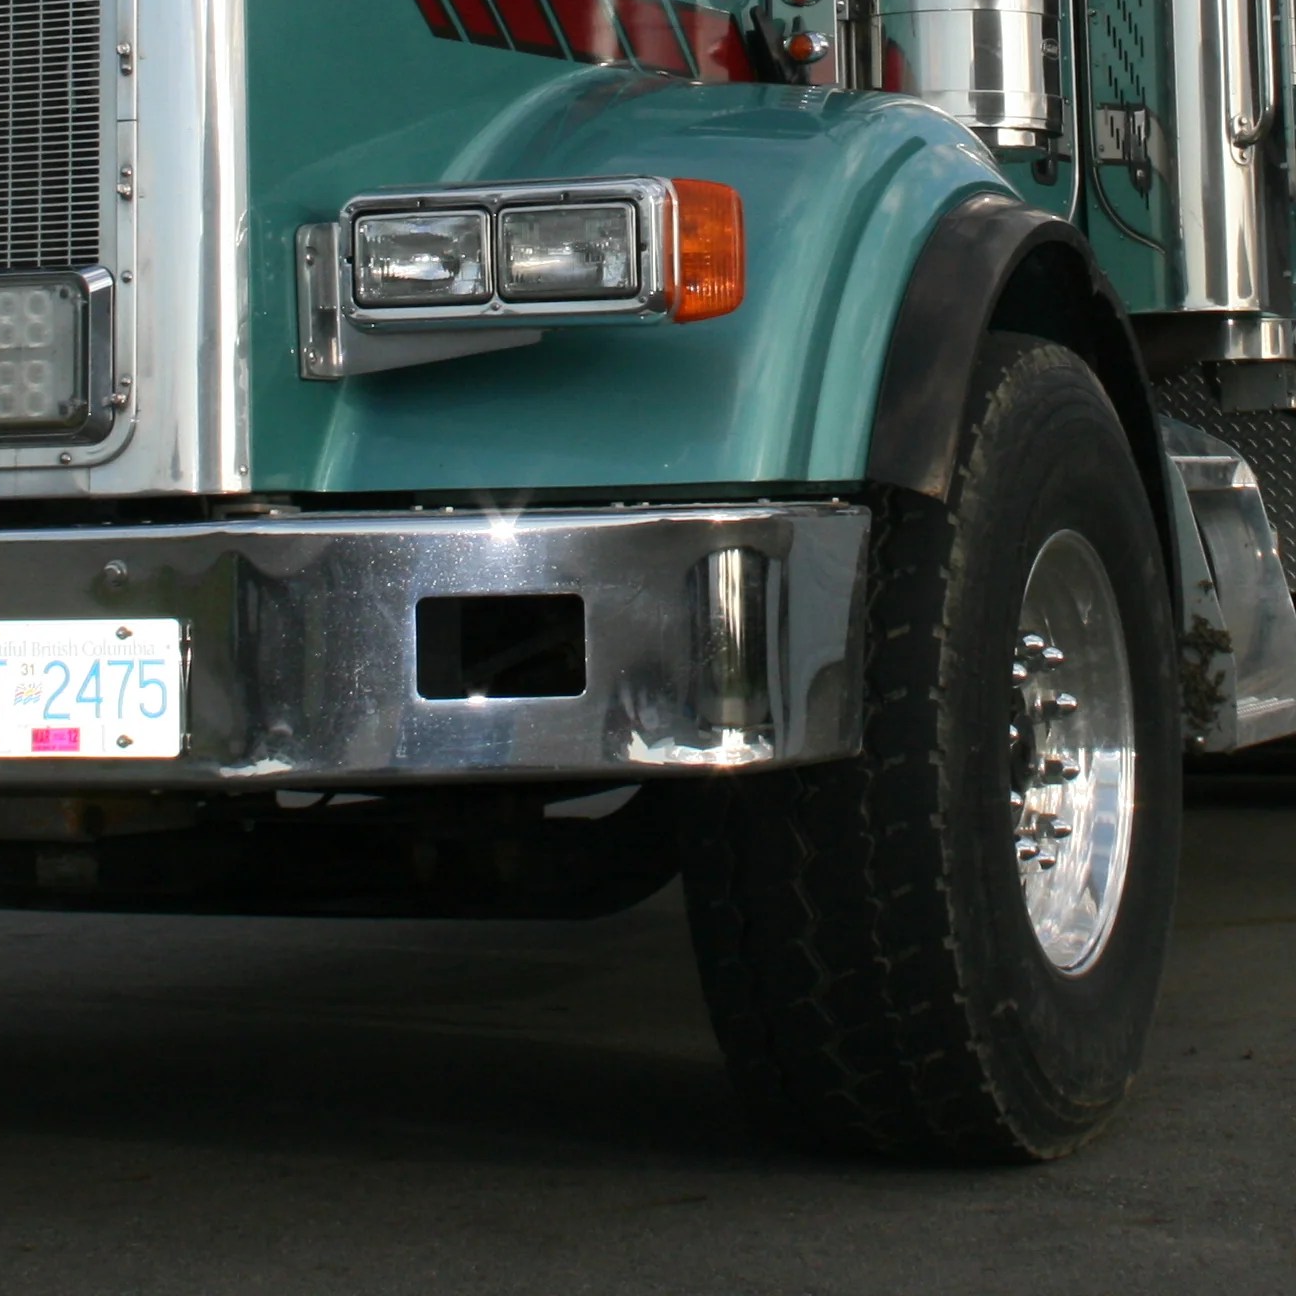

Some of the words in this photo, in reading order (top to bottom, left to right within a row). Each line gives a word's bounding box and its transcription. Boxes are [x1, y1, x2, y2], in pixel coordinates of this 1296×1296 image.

[32, 640, 78, 657] British
[82, 639, 155, 657] Columbia
[20, 663, 35, 676] 31
[43, 659, 167, 719] 2475
